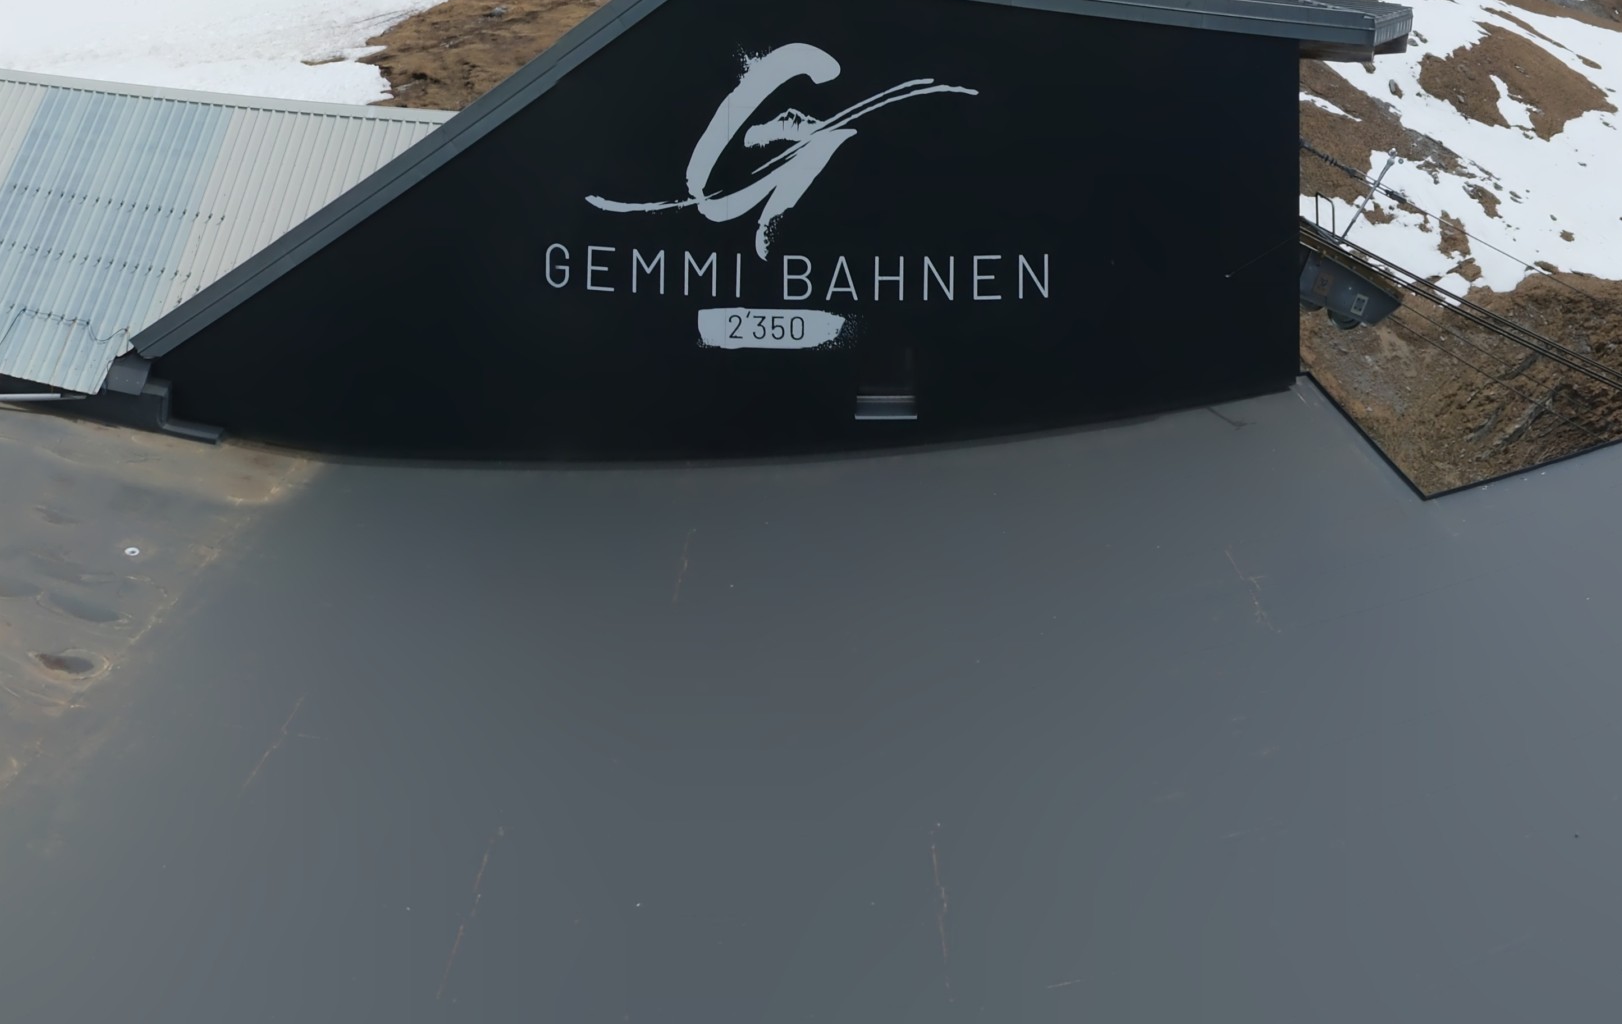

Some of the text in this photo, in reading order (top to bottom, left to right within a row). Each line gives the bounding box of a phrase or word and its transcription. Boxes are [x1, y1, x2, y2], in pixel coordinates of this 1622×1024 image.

[545, 242, 1049, 301] GEMMI BAHNEN
[728, 311, 805, 341] 2'350
